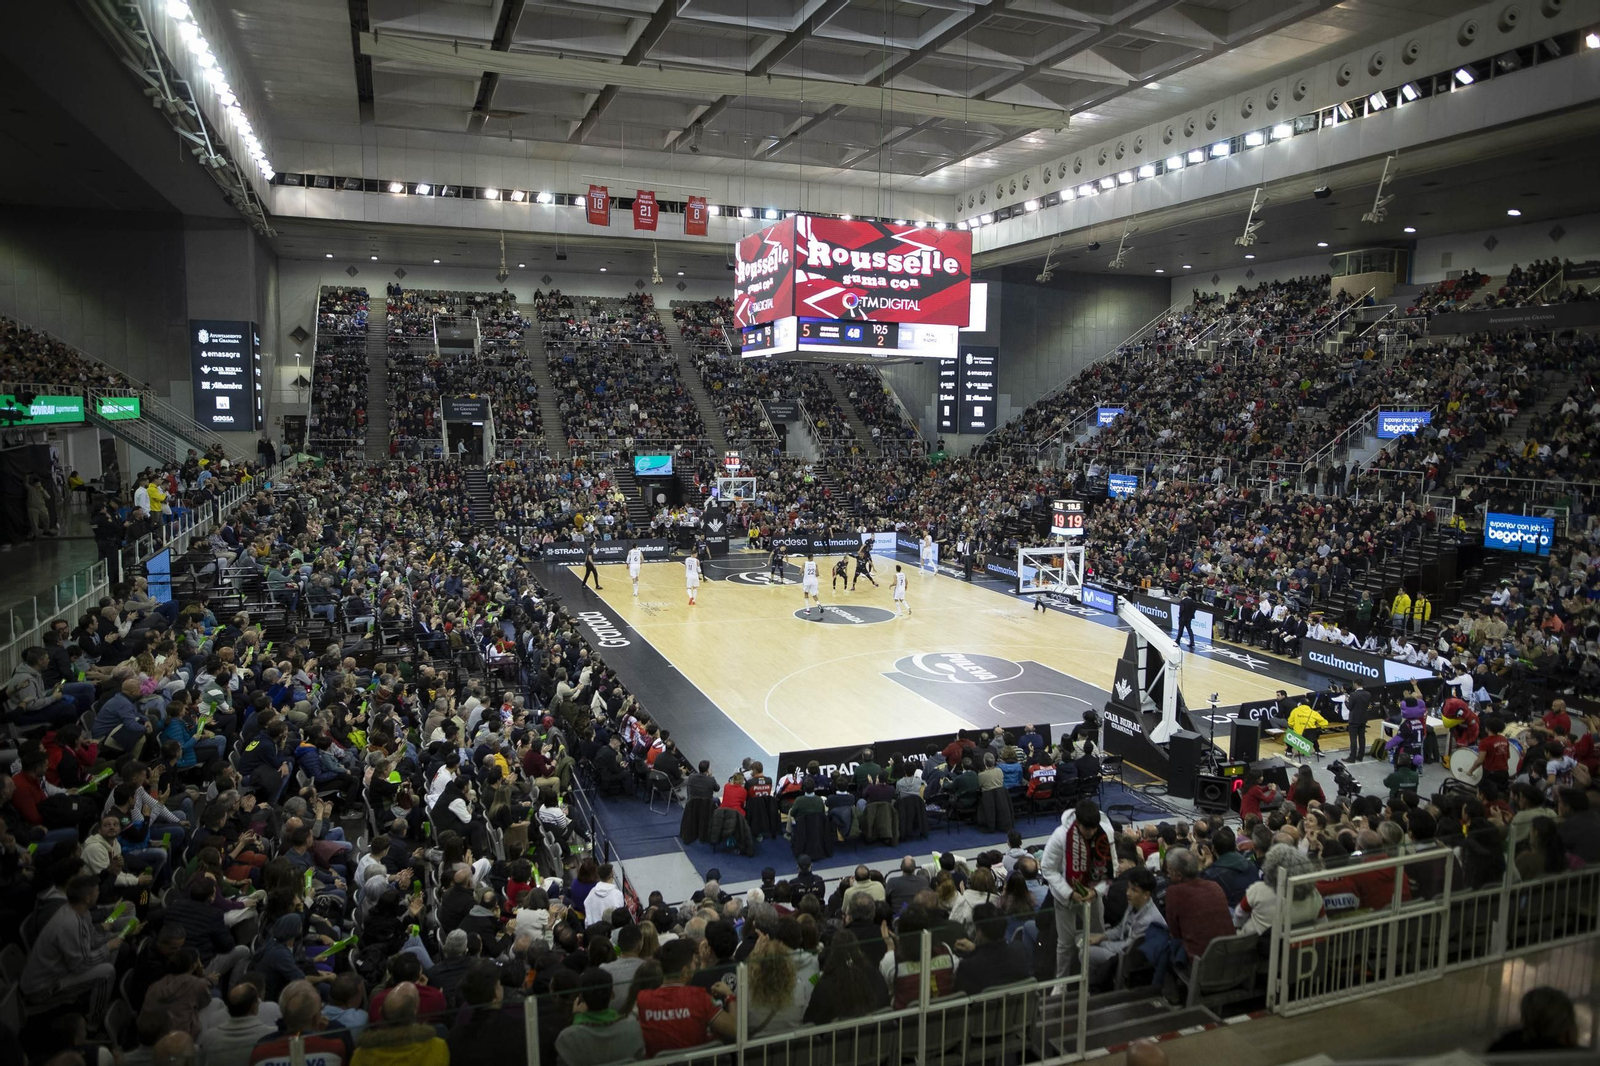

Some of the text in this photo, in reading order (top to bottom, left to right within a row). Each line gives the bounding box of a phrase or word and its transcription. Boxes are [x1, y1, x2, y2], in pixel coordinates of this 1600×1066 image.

[593, 197, 603, 210] 18
[640, 205, 651, 217] 21
[693, 208, 700, 220] 8
[738, 244, 789, 284] Rousselle
[807, 240, 959, 275] Rousselle
[842, 274, 919, 290] suma con
[803, 324, 810, 337] 5
[873, 325, 888, 335] 19.5
[877, 336, 884, 346] 2
[207, 351, 241, 359] emasagra
[211, 382, 242, 390] Alhambra
[1383, 422, 1419, 434] begobañ
[1053, 513, 1083, 528] 19 19
[1489, 521, 1516, 530] esponjas
[1517, 523, 1530, 531] con
[813, 538, 859, 547] azlmarino
[807, 568, 815, 576] 22
[987, 563, 1018, 578] azulmarino
[1095, 596, 1113, 607] Movistar
[1132, 602, 1169, 619] ulmarino
[577, 611, 631, 648] Granada
[940, 653, 998, 681] PULEVA
[1308, 651, 1380, 679] azulmarino
[1249, 701, 1280, 722] end
[1104, 710, 1142, 734] CAJA RURAL
[1110, 722, 1134, 737] GRANADA
[1417, 730, 1422, 743] 1
[908, 753, 928, 763] CAJA
[806, 761, 860, 778] TRAD
[1072, 826, 1080, 872] COVIRAN
[645, 1007, 691, 1021] PULEVA
